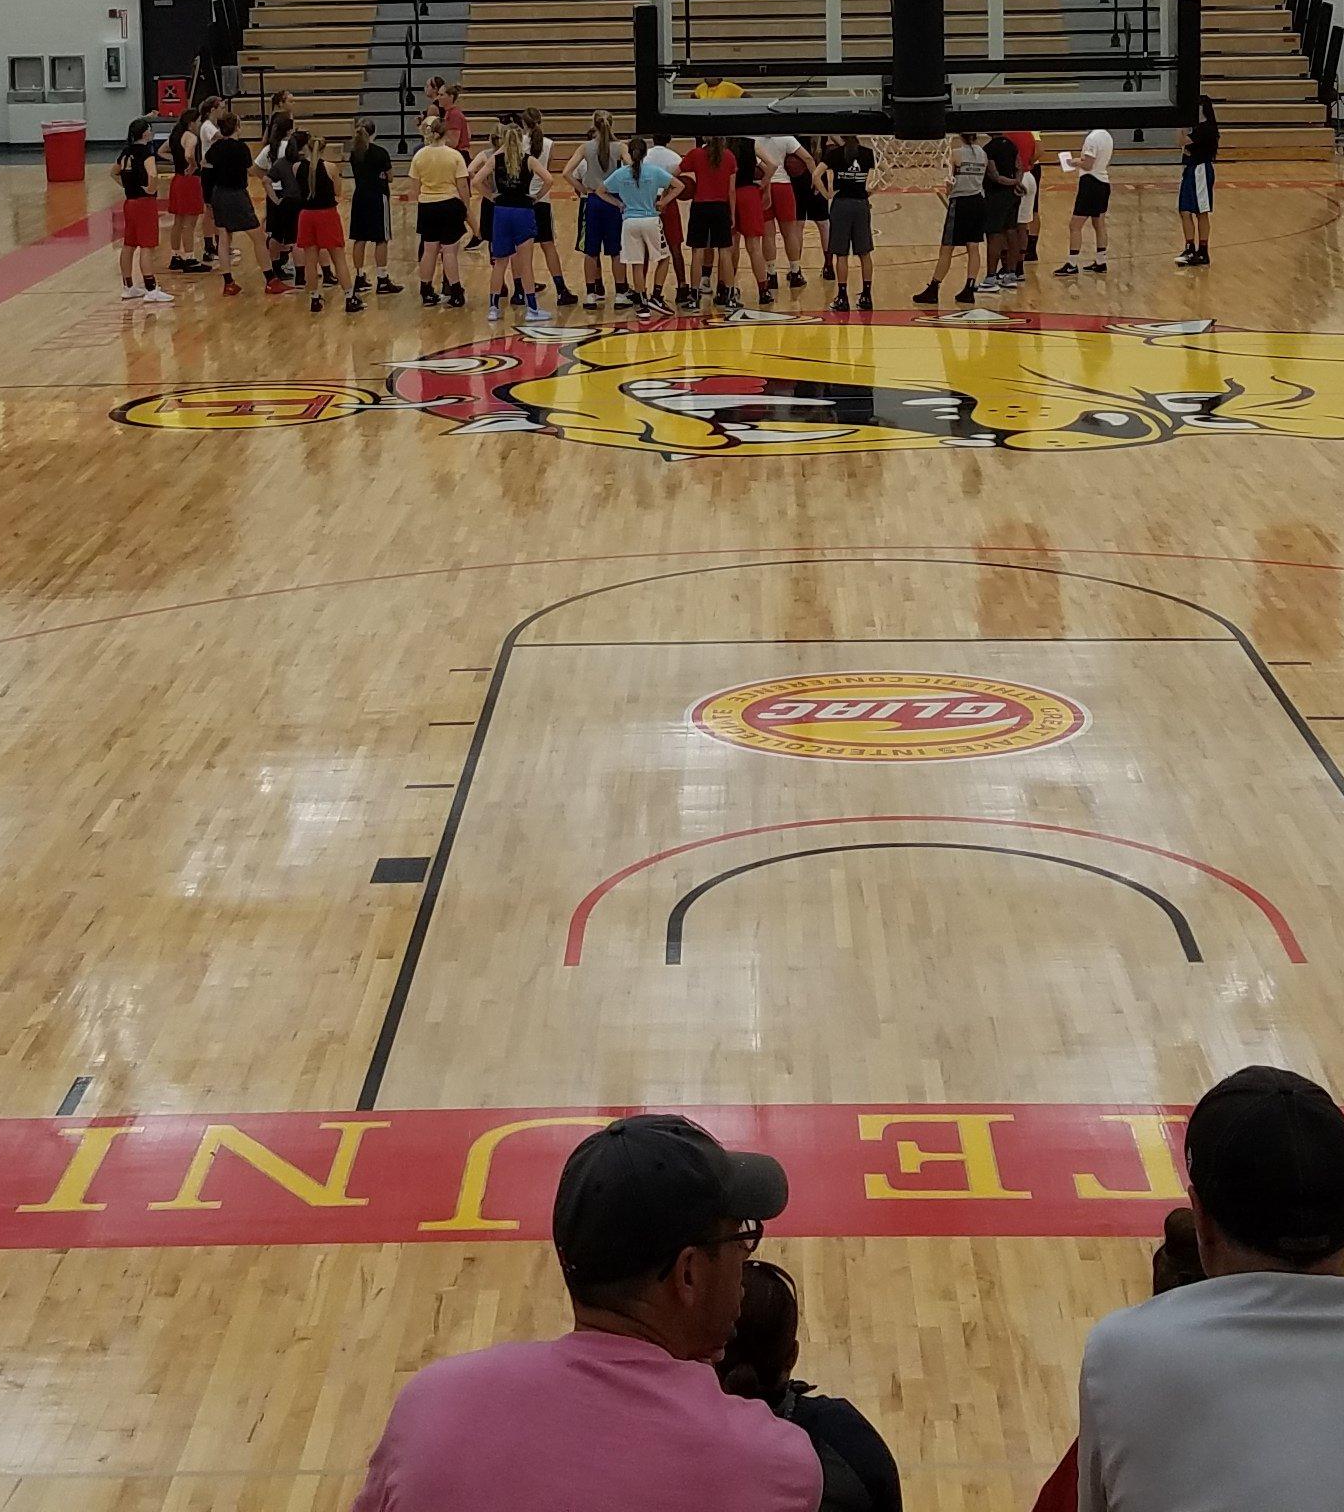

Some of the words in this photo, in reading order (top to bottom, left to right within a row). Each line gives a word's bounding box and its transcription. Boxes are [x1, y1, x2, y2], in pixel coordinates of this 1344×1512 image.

[728, 676, 905, 704] CONFERENCE
[917, 676, 1045, 702] ATHLETIC
[757, 702, 1007, 719] GLIAC
[1030, 706, 1065, 738] GREAT
[711, 708, 926, 756] INTERCOLLEGIATE
[937, 734, 1031, 754] LAKES
